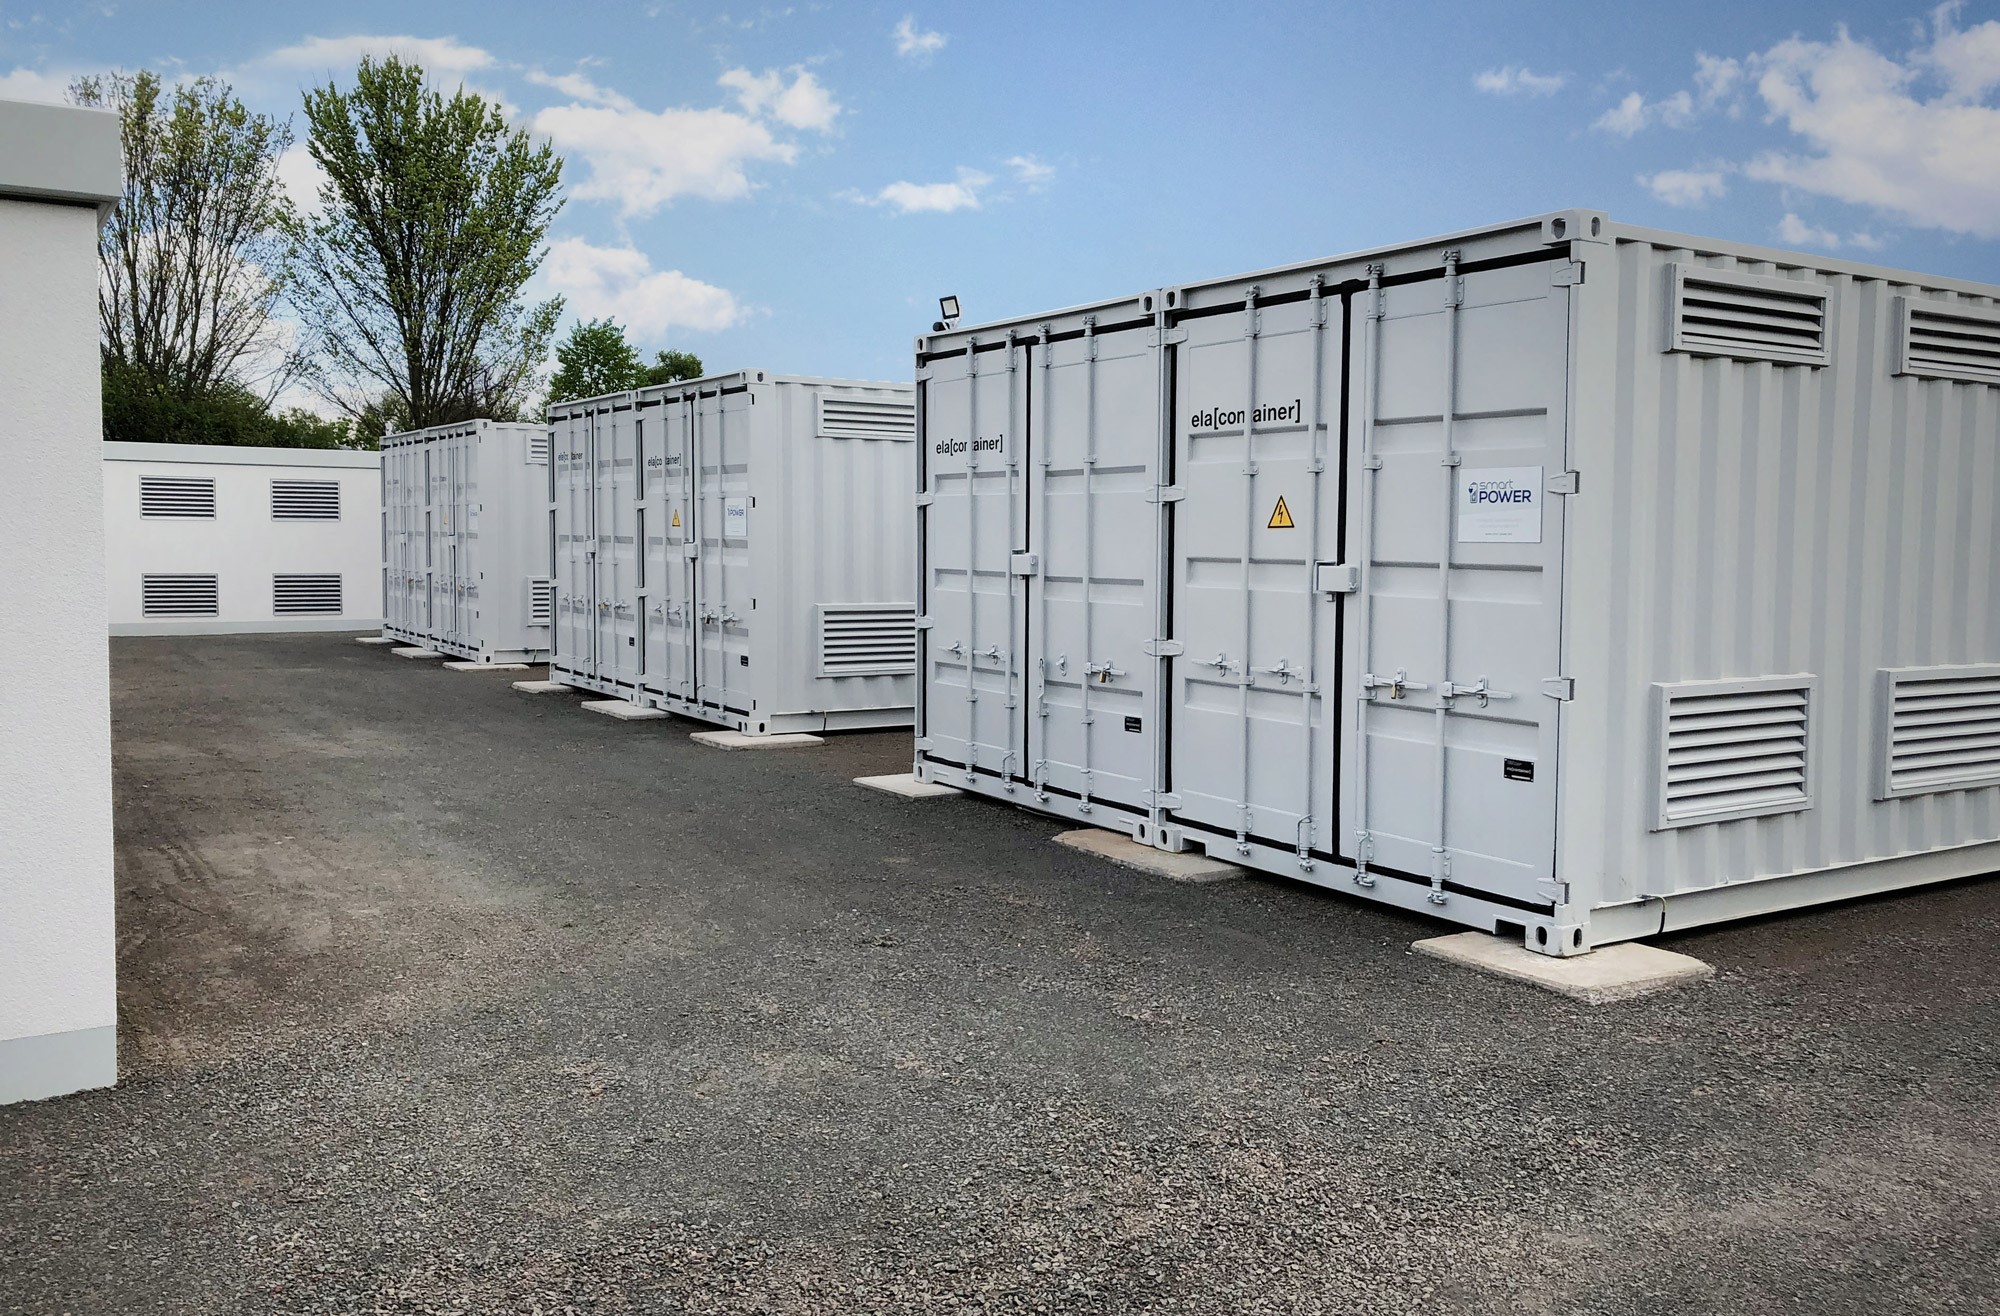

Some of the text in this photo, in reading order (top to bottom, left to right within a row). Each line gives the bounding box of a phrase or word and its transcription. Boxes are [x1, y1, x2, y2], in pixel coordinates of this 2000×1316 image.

[1191, 399, 1301, 430] ela[conainer]
[1479, 479, 1514, 490] smart
[1479, 489, 1532, 503] POWER
